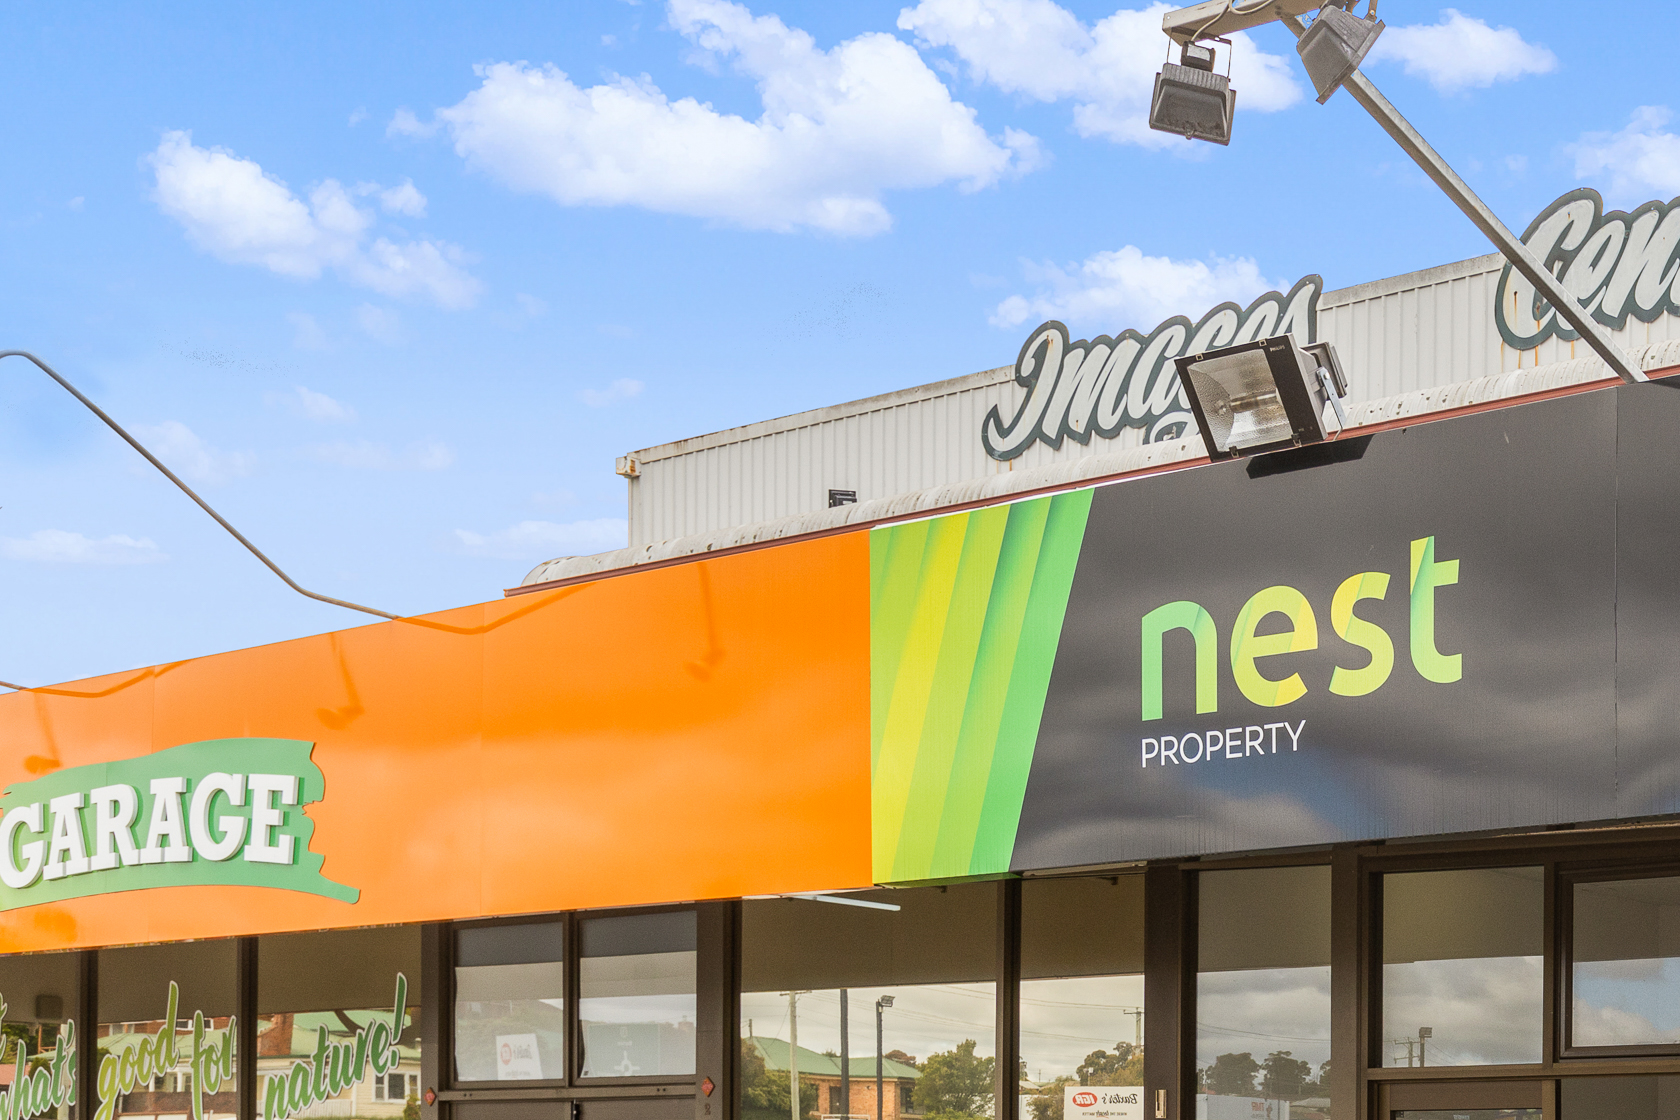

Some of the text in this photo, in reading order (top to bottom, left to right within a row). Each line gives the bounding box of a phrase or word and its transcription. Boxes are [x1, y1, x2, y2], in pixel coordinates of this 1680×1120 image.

[1141, 535, 1462, 721] nest
[1141, 719, 1307, 768] PROPERTY
[0, 772, 299, 889] GARAGE
